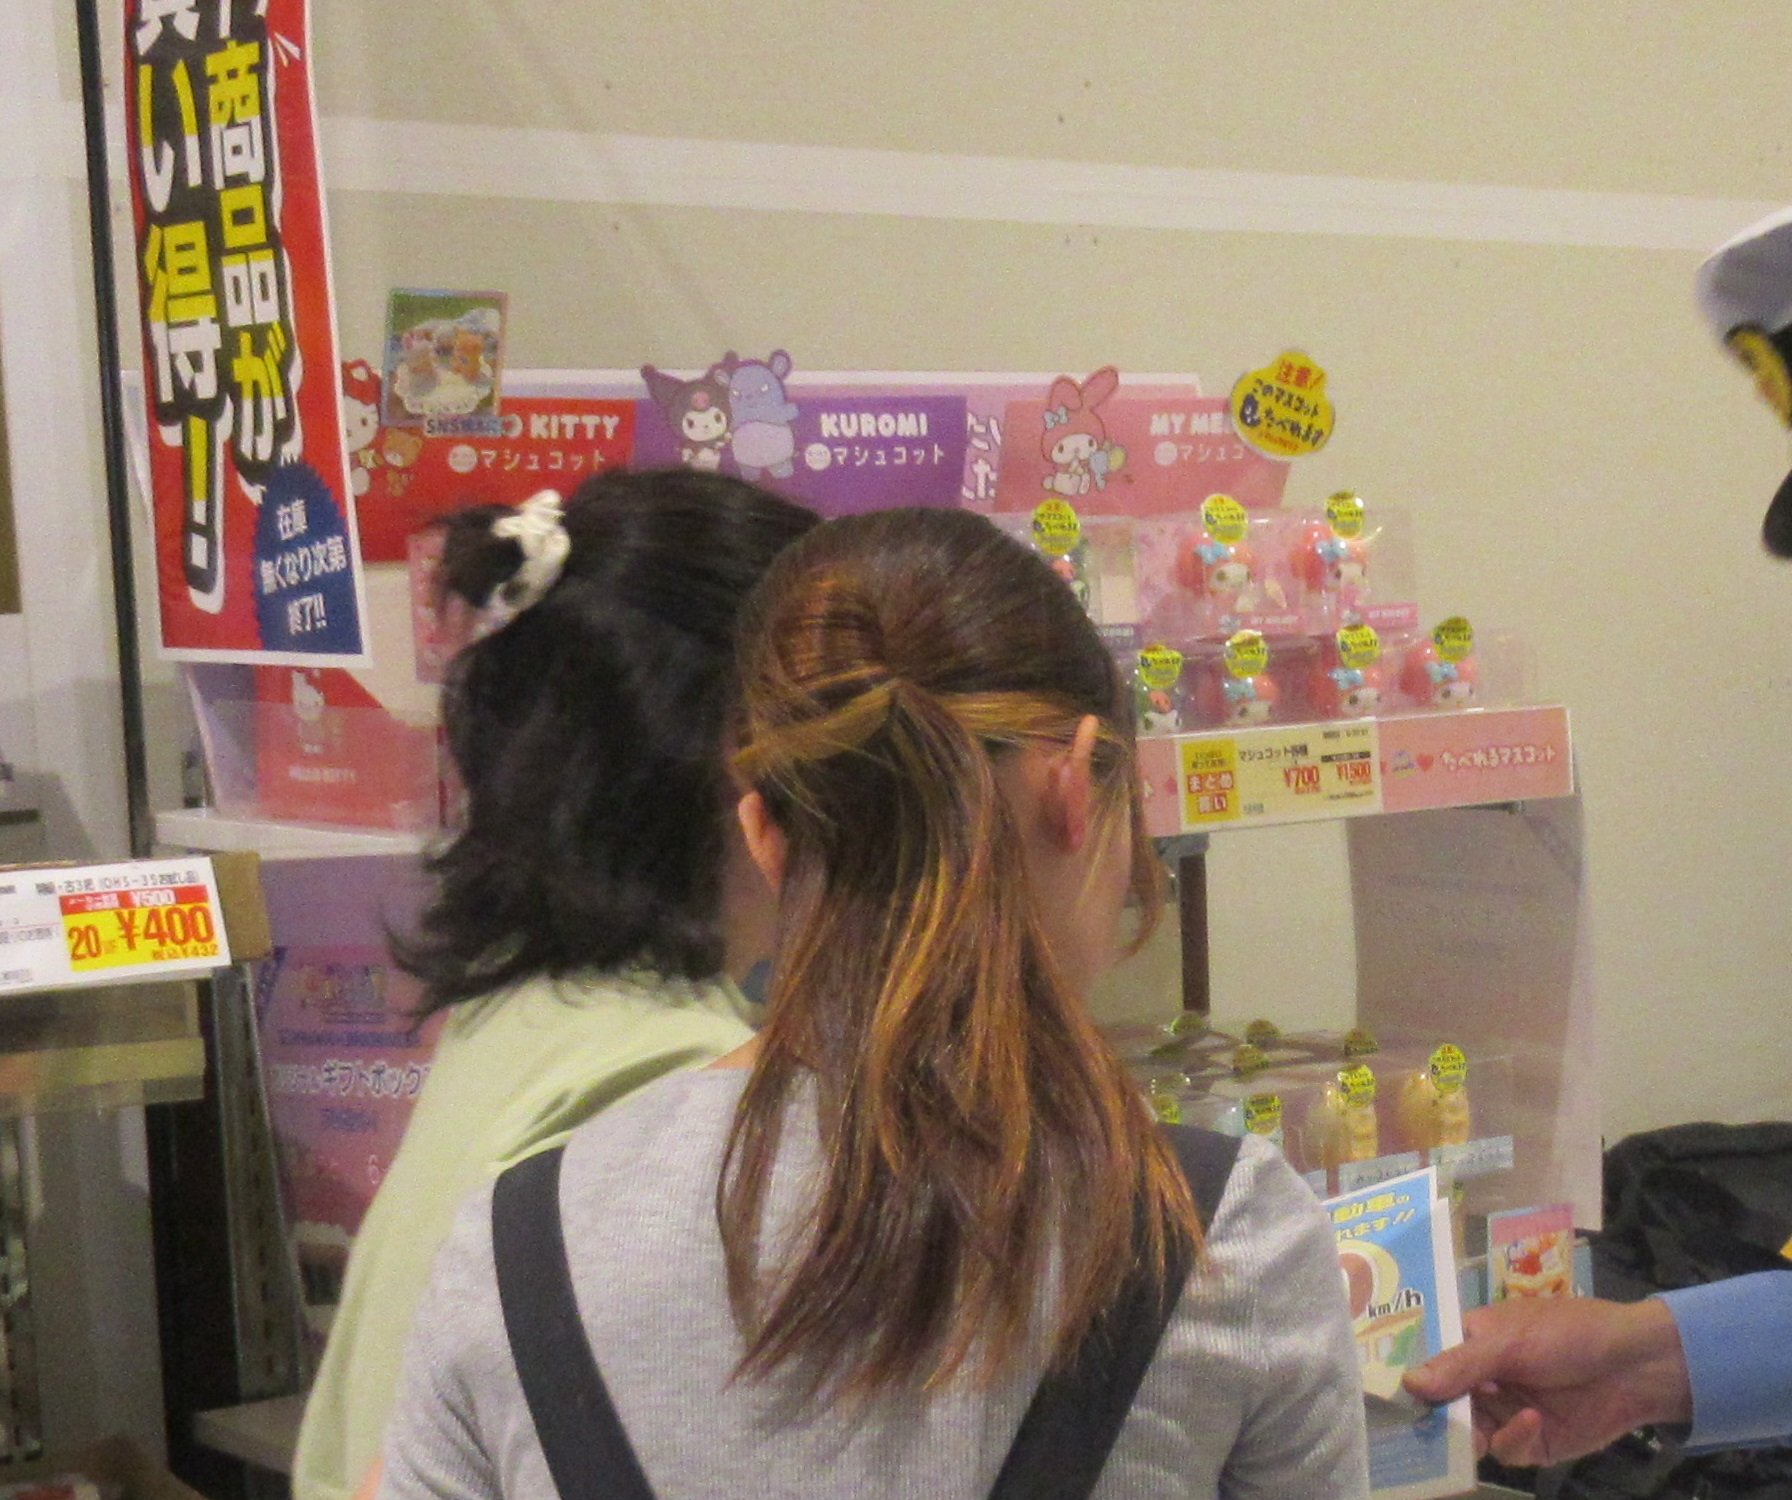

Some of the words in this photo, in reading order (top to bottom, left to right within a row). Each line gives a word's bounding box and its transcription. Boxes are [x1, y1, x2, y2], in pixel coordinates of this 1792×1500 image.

[206, 0, 294, 464] 商品が
[529, 413, 620, 440] KITTY
[819, 411, 930, 438] KUROMI
[1150, 411, 1186, 436] MY
[479, 447, 606, 472] マシュコット
[832, 441, 945, 467] マシュコット
[276, 499, 308, 541] 在庫
[260, 535, 348, 595] 無くなり次第
[68, 924, 102, 961] 20
[116, 906, 215, 951] ¥400
[1367, 1287, 1423, 1320] km/h
